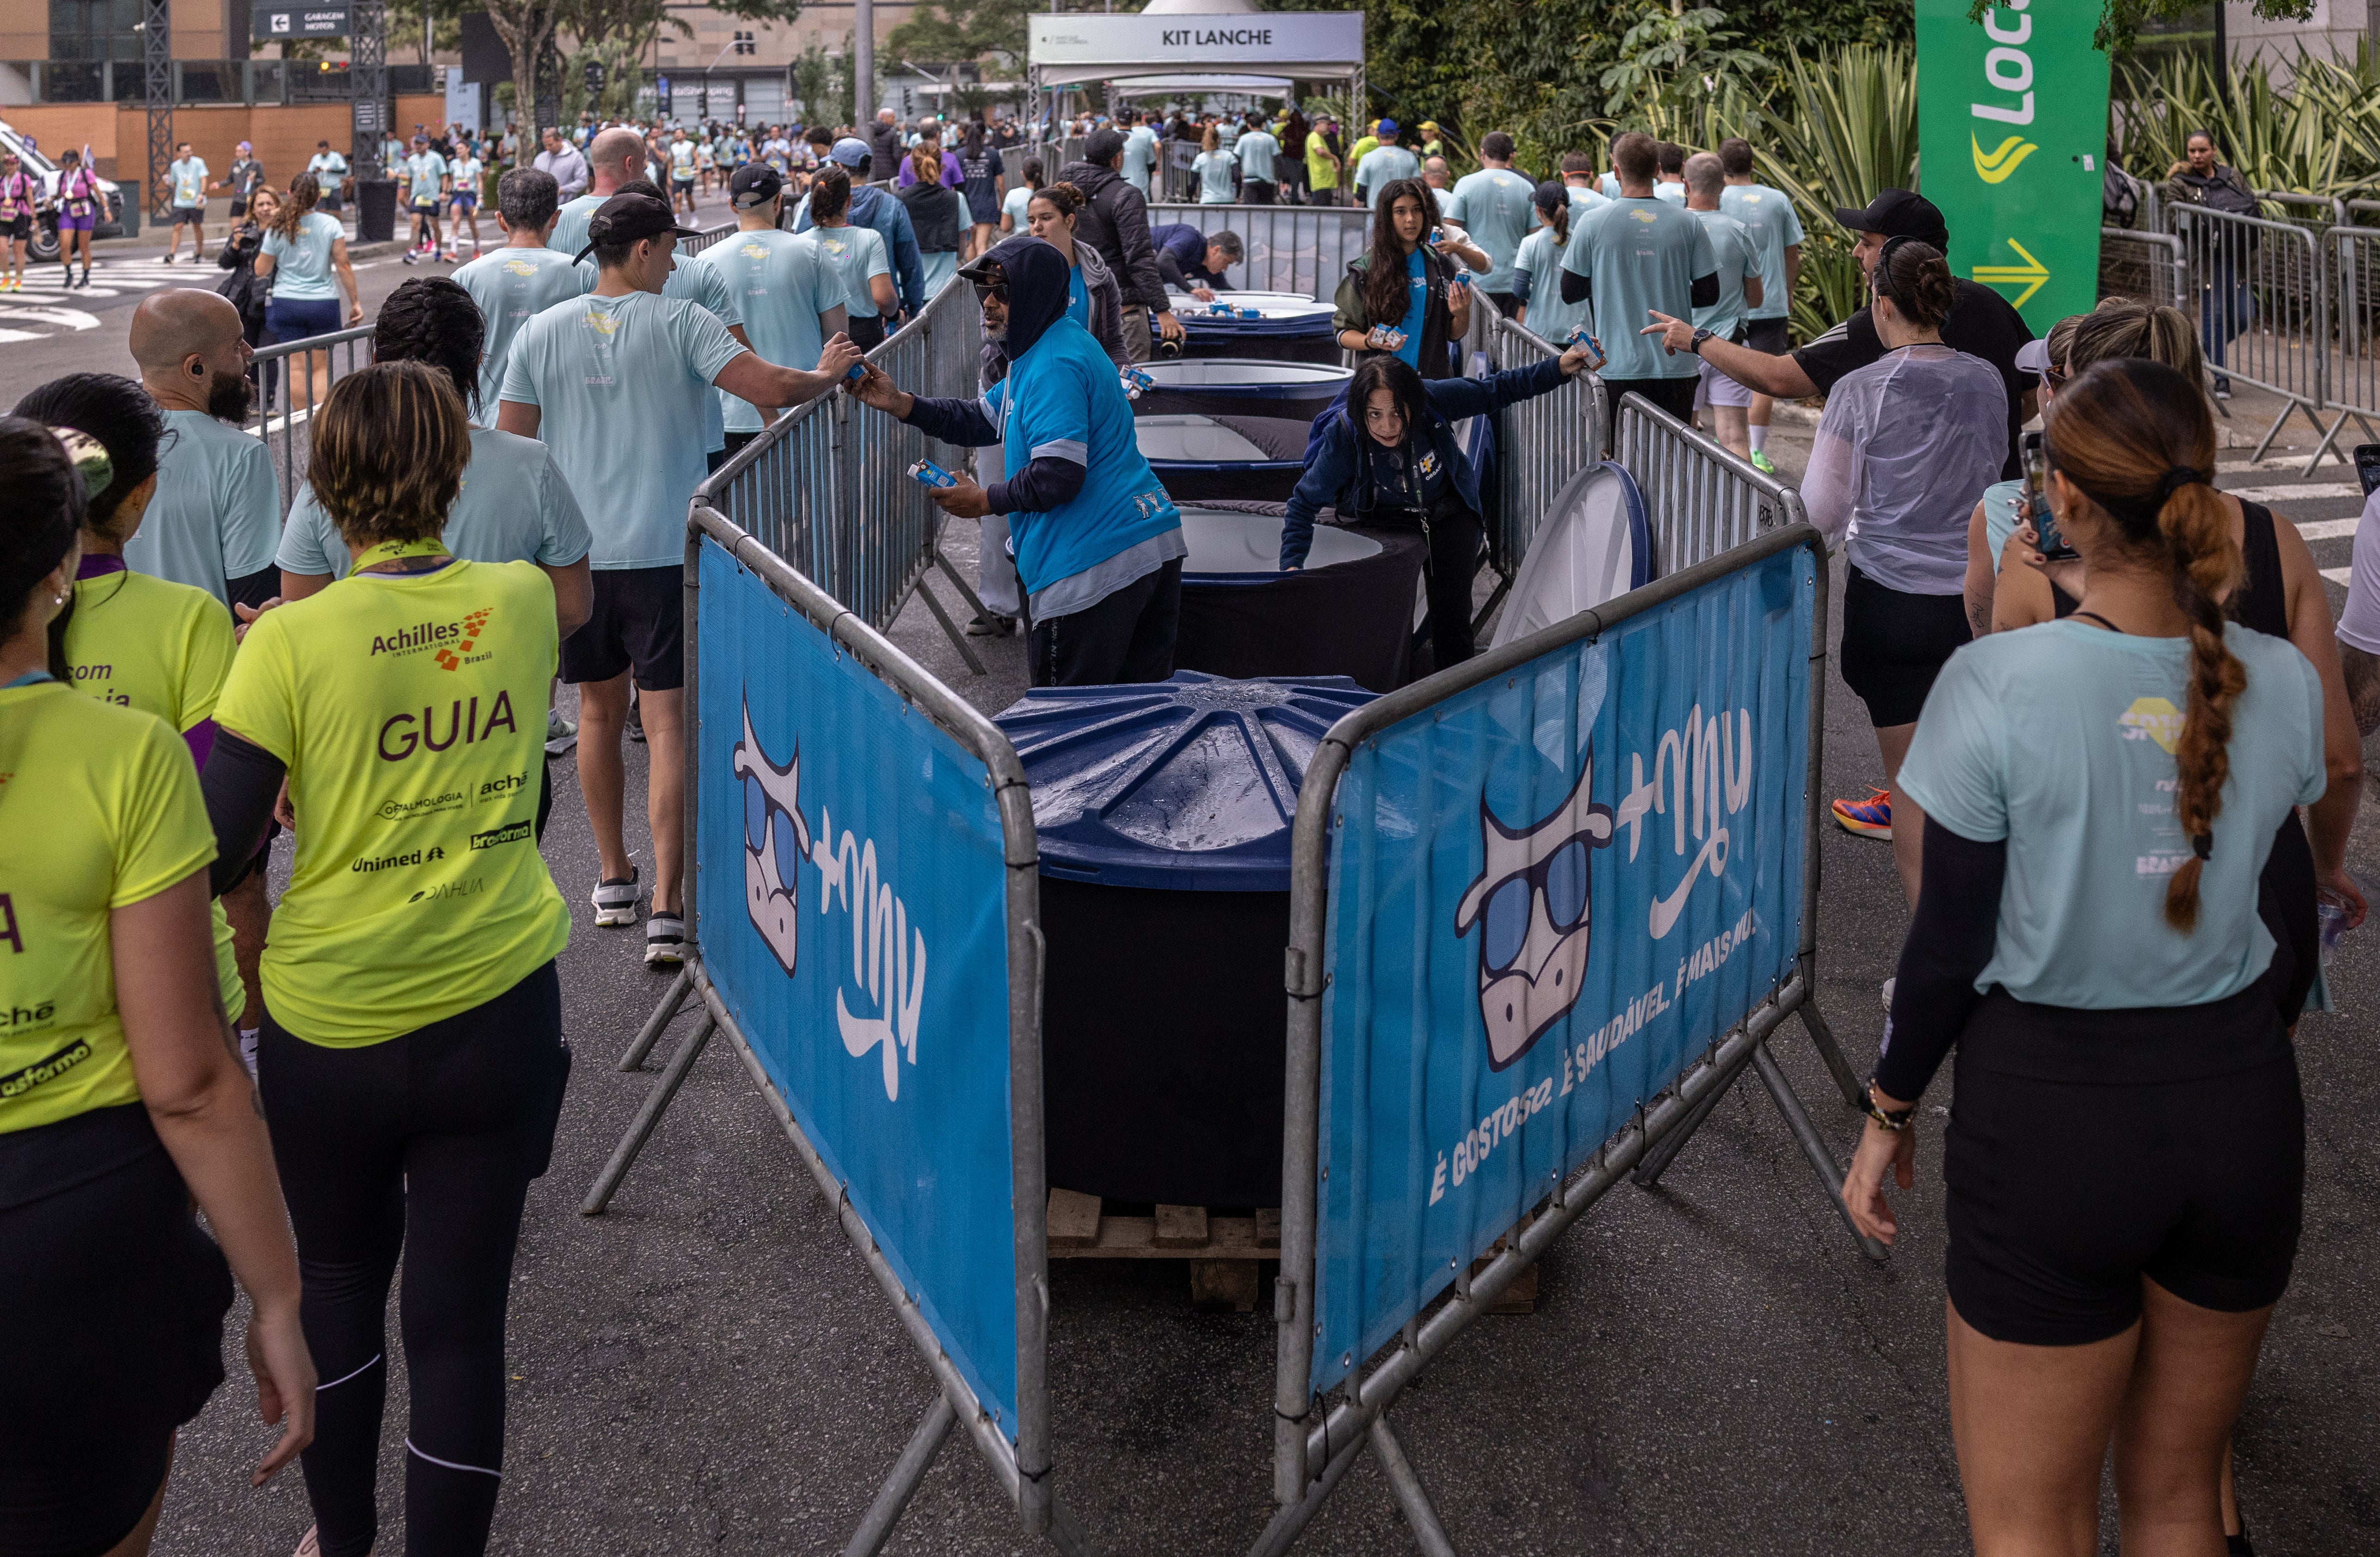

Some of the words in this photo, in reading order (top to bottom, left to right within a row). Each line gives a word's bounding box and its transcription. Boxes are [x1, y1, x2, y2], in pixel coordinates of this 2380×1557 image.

[304, 12, 345, 21] GARAGEM
[304, 22, 335, 31] MOTOS
[1162, 30, 1191, 45] KIT
[1196, 30, 1272, 45] LANCHE
[371, 622, 459, 656] Achilles
[393, 638, 461, 658] INTERNATIONAL
[464, 651, 492, 664] Brazil
[378, 690, 516, 762] GUIA
[352, 850, 420, 872] Unimed
[1429, 1150, 1447, 1207] É
[1452, 1077, 1552, 1187] GOSTOSO.
[1559, 1048, 1573, 1097] É
[1576, 981, 1670, 1084] SAUDÁVEL.
[1675, 957, 1687, 997] É
[1686, 930, 1731, 986] MAIS
[1731, 907, 1757, 952] MU.
